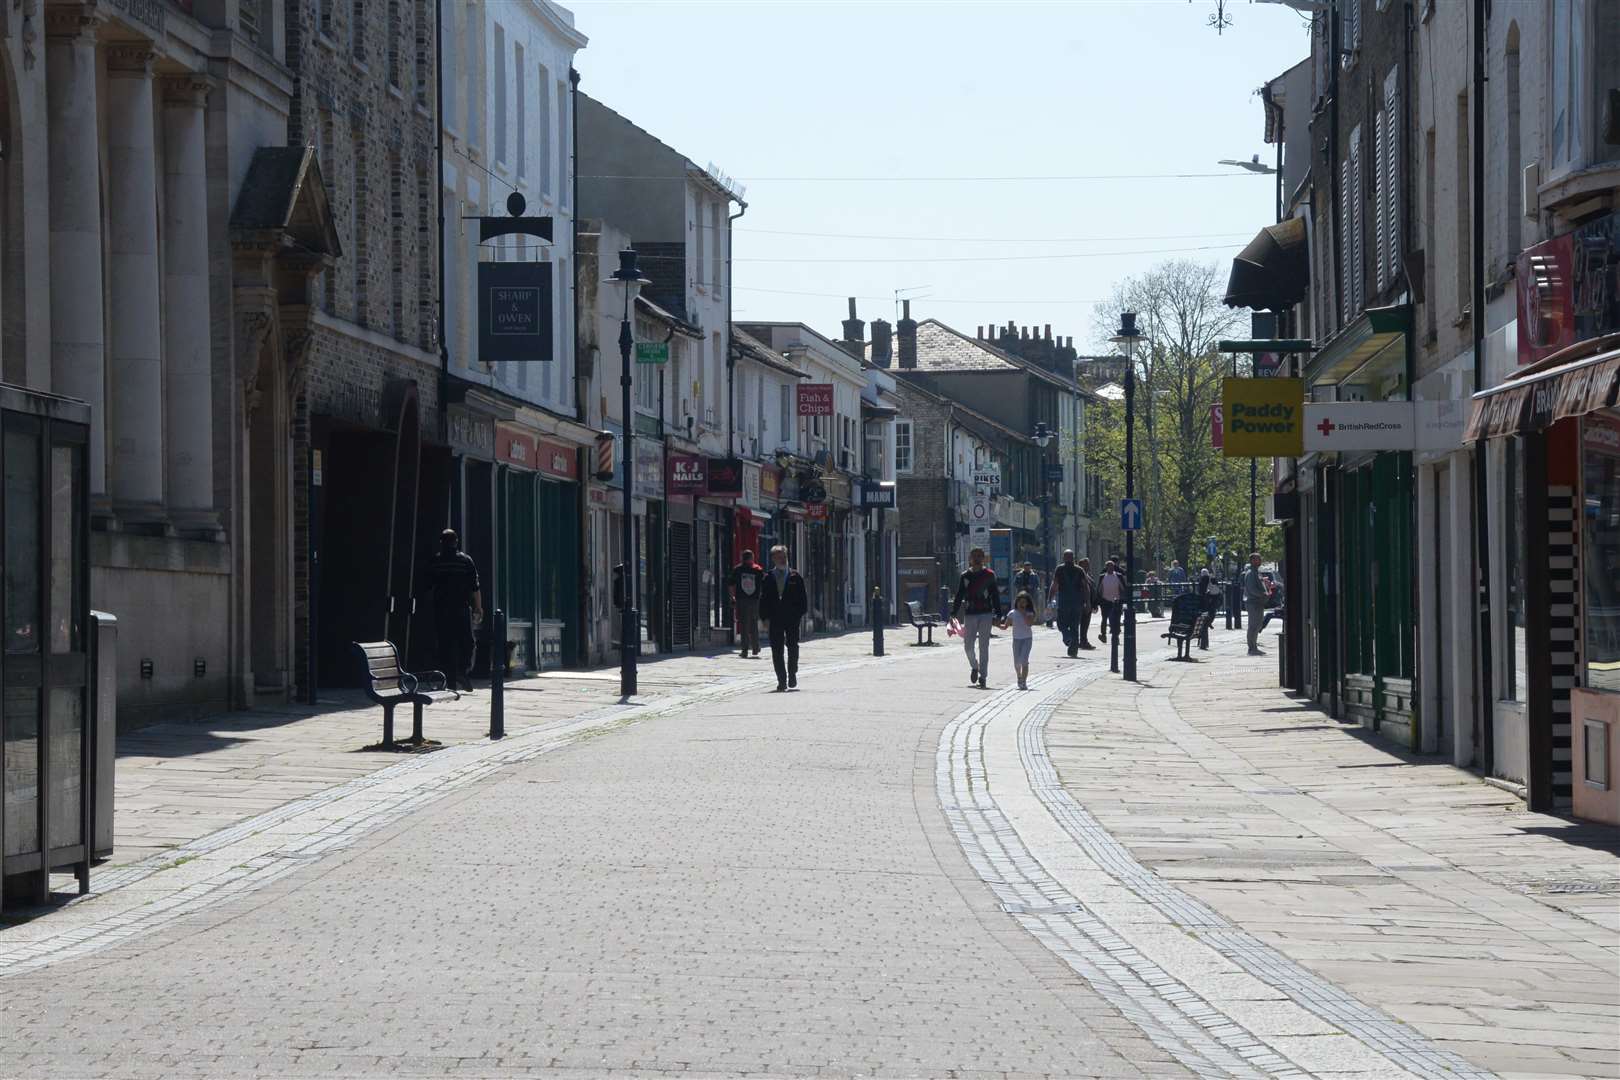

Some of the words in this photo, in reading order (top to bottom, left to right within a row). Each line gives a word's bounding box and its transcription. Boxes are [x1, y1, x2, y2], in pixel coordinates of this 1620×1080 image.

[498, 291, 532, 301] SHARP
[511, 304, 519, 312] &
[498, 313, 532, 323] OWEN
[800, 393, 821, 402] Fish
[822, 393, 830, 402] &
[799, 403, 830, 415] Chips
[1232, 403, 1295, 421] Paddy
[1232, 419, 1296, 433] Power
[1338, 423, 1401, 431] BritishRedCross
[672, 473, 704, 481] NAILS
